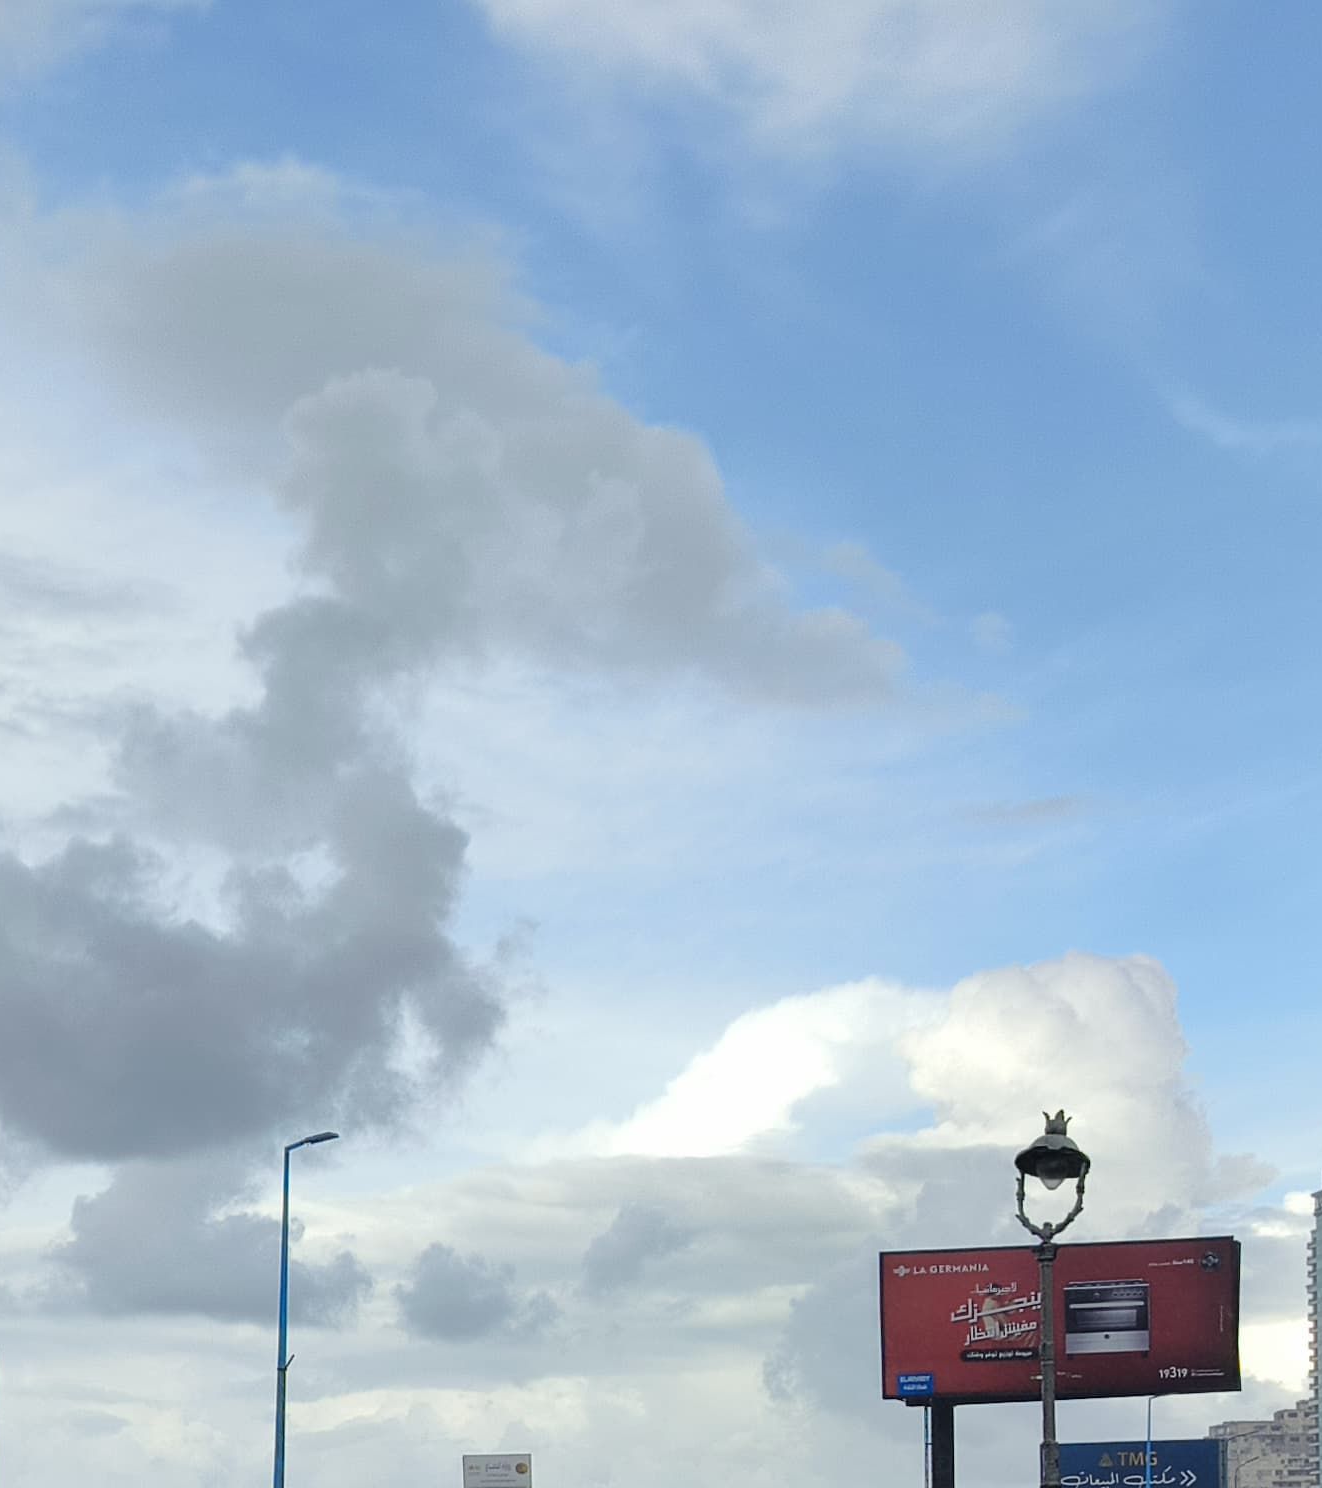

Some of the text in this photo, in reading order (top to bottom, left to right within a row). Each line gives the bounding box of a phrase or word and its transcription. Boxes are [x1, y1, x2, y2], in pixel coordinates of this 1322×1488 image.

[913, 1263, 990, 1275] LA GERMANIA
[1158, 1366, 1188, 1379] 19319
